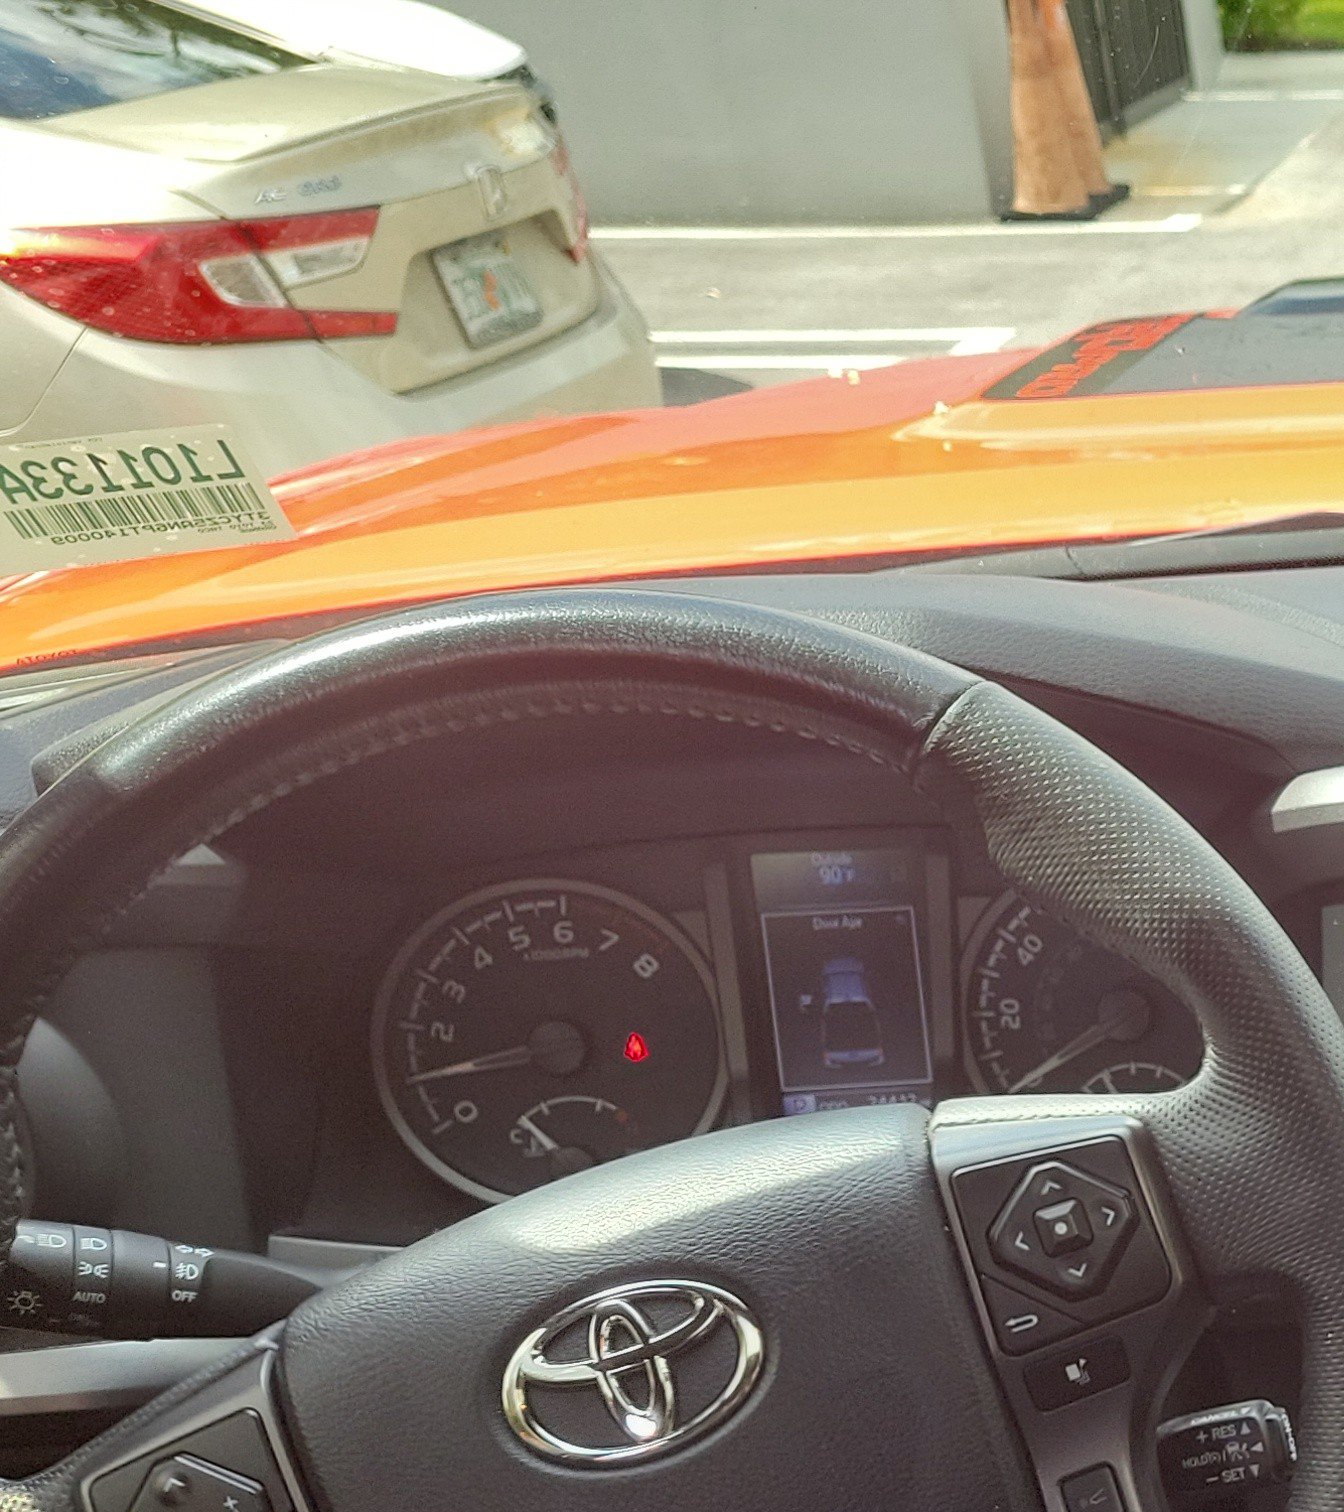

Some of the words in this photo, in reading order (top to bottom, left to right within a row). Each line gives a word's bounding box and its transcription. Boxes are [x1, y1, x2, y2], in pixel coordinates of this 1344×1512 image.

[507, 925, 531, 951] 5
[553, 920, 575, 944] 6
[600, 928, 621, 951] 7
[473, 946, 493, 970] 4
[1017, 934, 1043, 967] 40
[632, 953, 660, 979] 8
[441, 980, 466, 1004] 3
[1000, 998, 1022, 1030] 20
[432, 1022, 455, 1043] 2
[454, 1100, 479, 1125] 0
[73, 1290, 106, 1305] AUTO
[171, 1289, 197, 1302] OFF
[1212, 1425, 1237, 1442] RES
